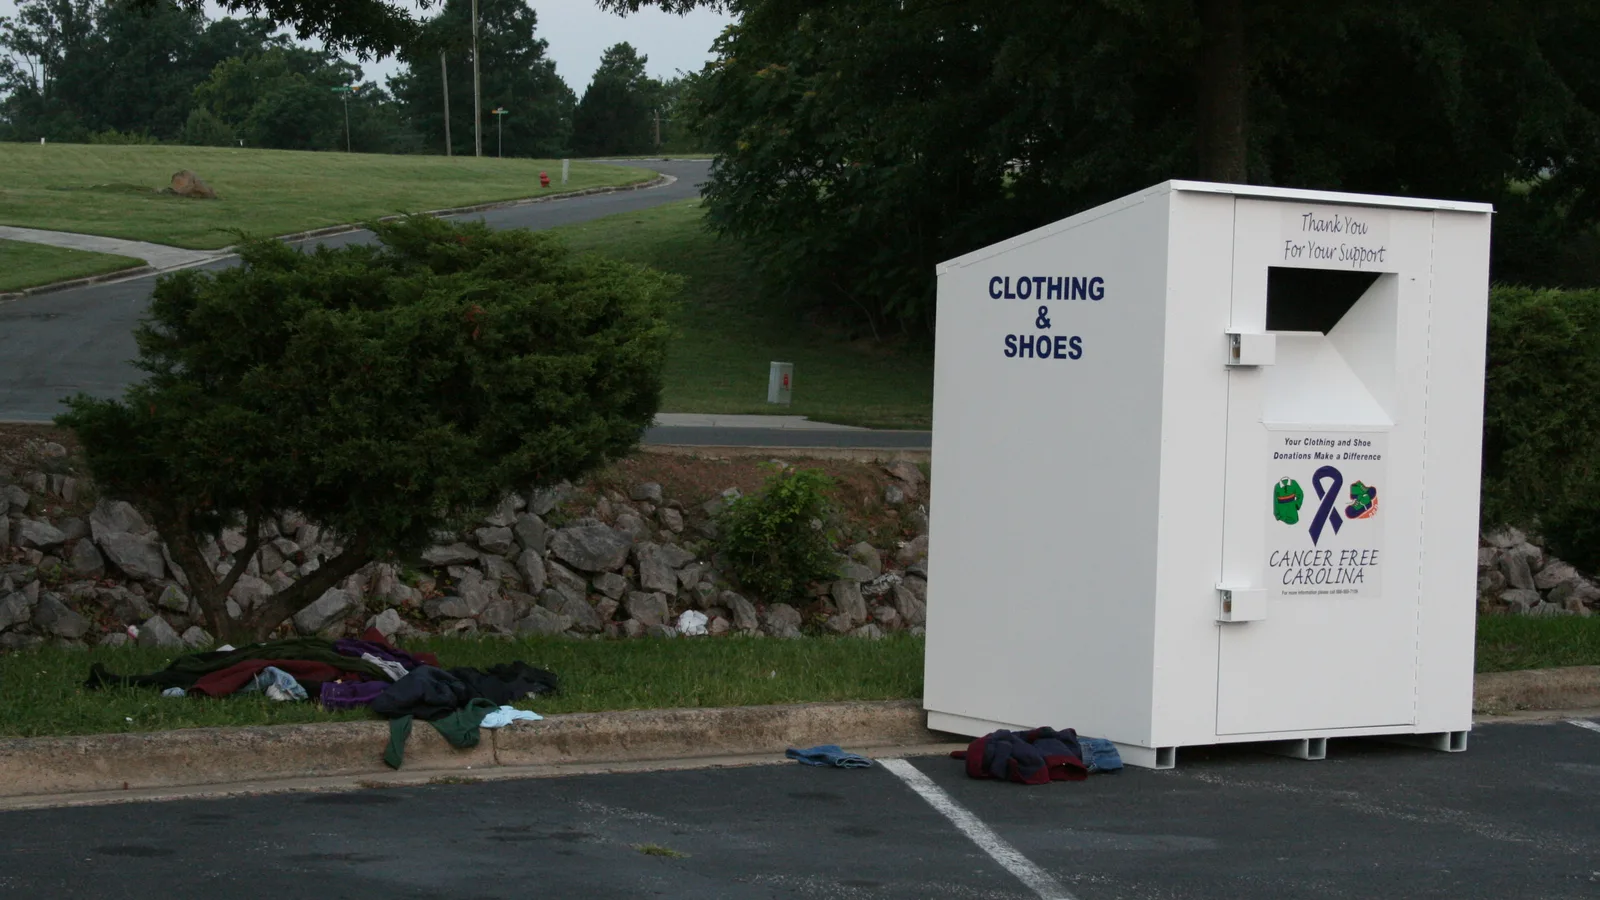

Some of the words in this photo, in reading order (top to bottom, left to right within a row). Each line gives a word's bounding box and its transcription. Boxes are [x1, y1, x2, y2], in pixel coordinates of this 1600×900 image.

[1302, 212, 1343, 233] Thank
[1344, 216, 1369, 235] You
[1284, 240, 1306, 260] For
[1308, 240, 1337, 260] Your
[1338, 243, 1386, 268] Support
[988, 275, 1105, 301] CLOTHING
[1035, 305, 1052, 329] &
[1003, 333, 1083, 360] SHOES
[1284, 437, 1302, 447] Your
[1303, 437, 1336, 448] Clothing
[1337, 438, 1352, 447] and
[1353, 438, 1372, 447] Shoe
[1273, 451, 1312, 460] Donations
[1313, 451, 1334, 460] Make
[1342, 452, 1382, 461] Difference
[1269, 549, 1334, 568] CANCER
[1338, 549, 1380, 567] FREE
[1282, 567, 1365, 585] CAROLINA
